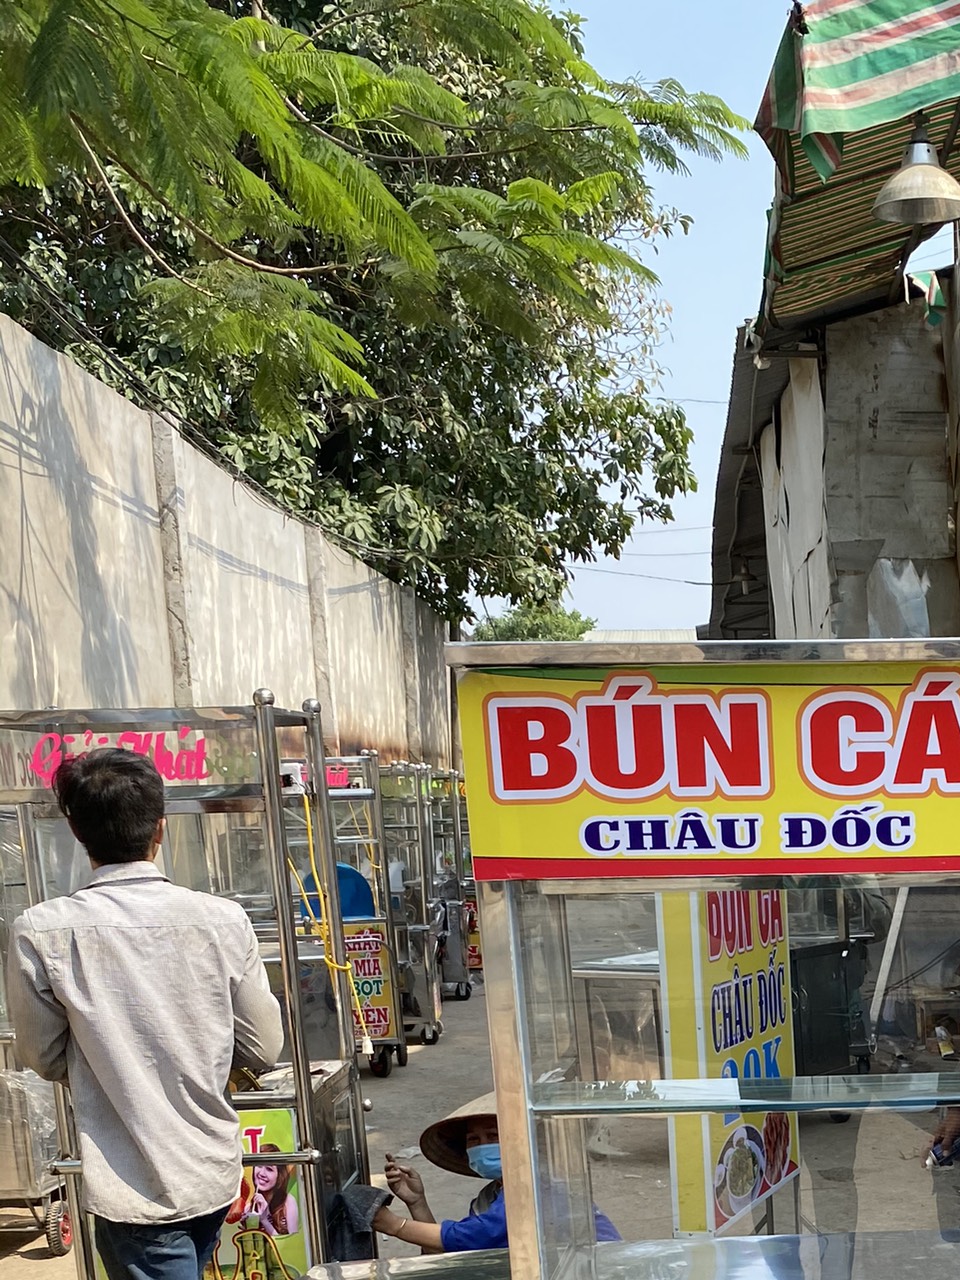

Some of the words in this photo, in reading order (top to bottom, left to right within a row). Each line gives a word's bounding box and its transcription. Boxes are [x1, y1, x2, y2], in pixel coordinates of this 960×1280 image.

[495, 684, 762, 791] BÚN
[583, 811, 759, 851] CHÂU
[783, 805, 912, 848] ĐỐC
[711, 964, 754, 1054] CHÂU
[757, 946, 787, 1036] ĐỐC
